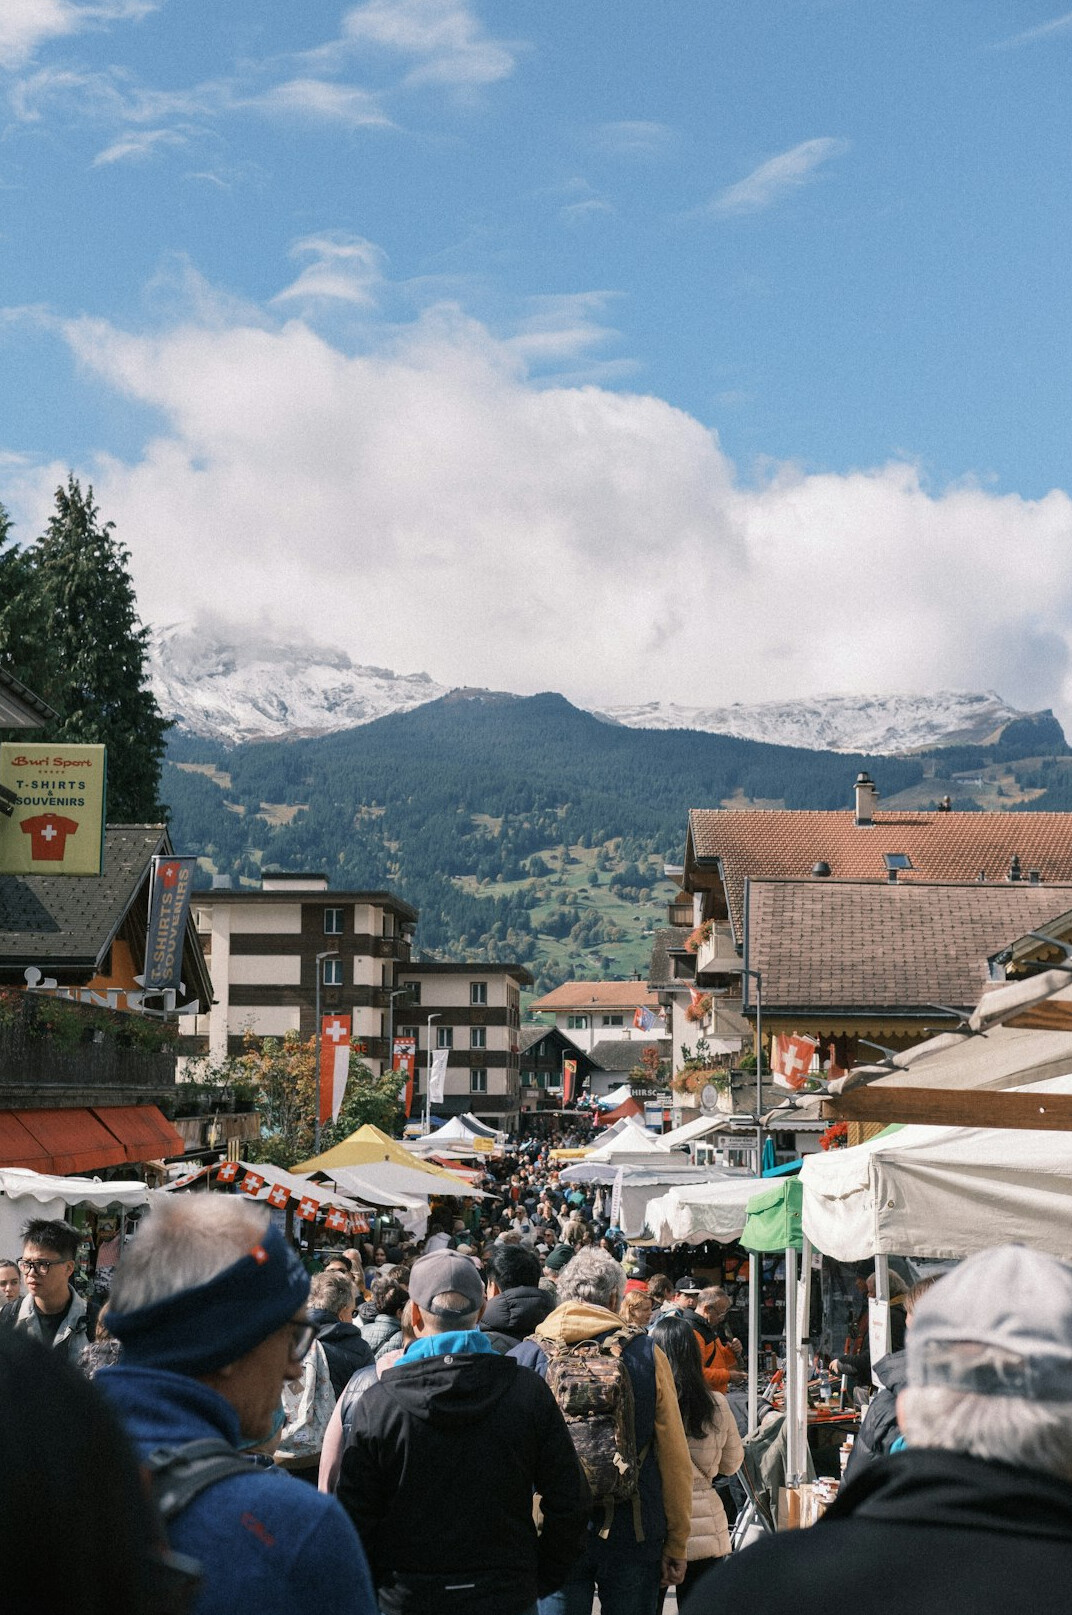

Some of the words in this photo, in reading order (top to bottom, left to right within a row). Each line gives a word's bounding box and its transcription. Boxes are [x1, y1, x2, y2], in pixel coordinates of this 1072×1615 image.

[11, 756, 50, 767] Buri
[53, 757, 92, 768] Sport
[16, 780, 86, 790] T-SHIRTS
[16, 797, 85, 807] SOUVENIRS
[163, 868, 189, 980] SOUVENIRS
[151, 892, 173, 980] T-SHIRTS
[631, 1089, 658, 1097] HIRSC
